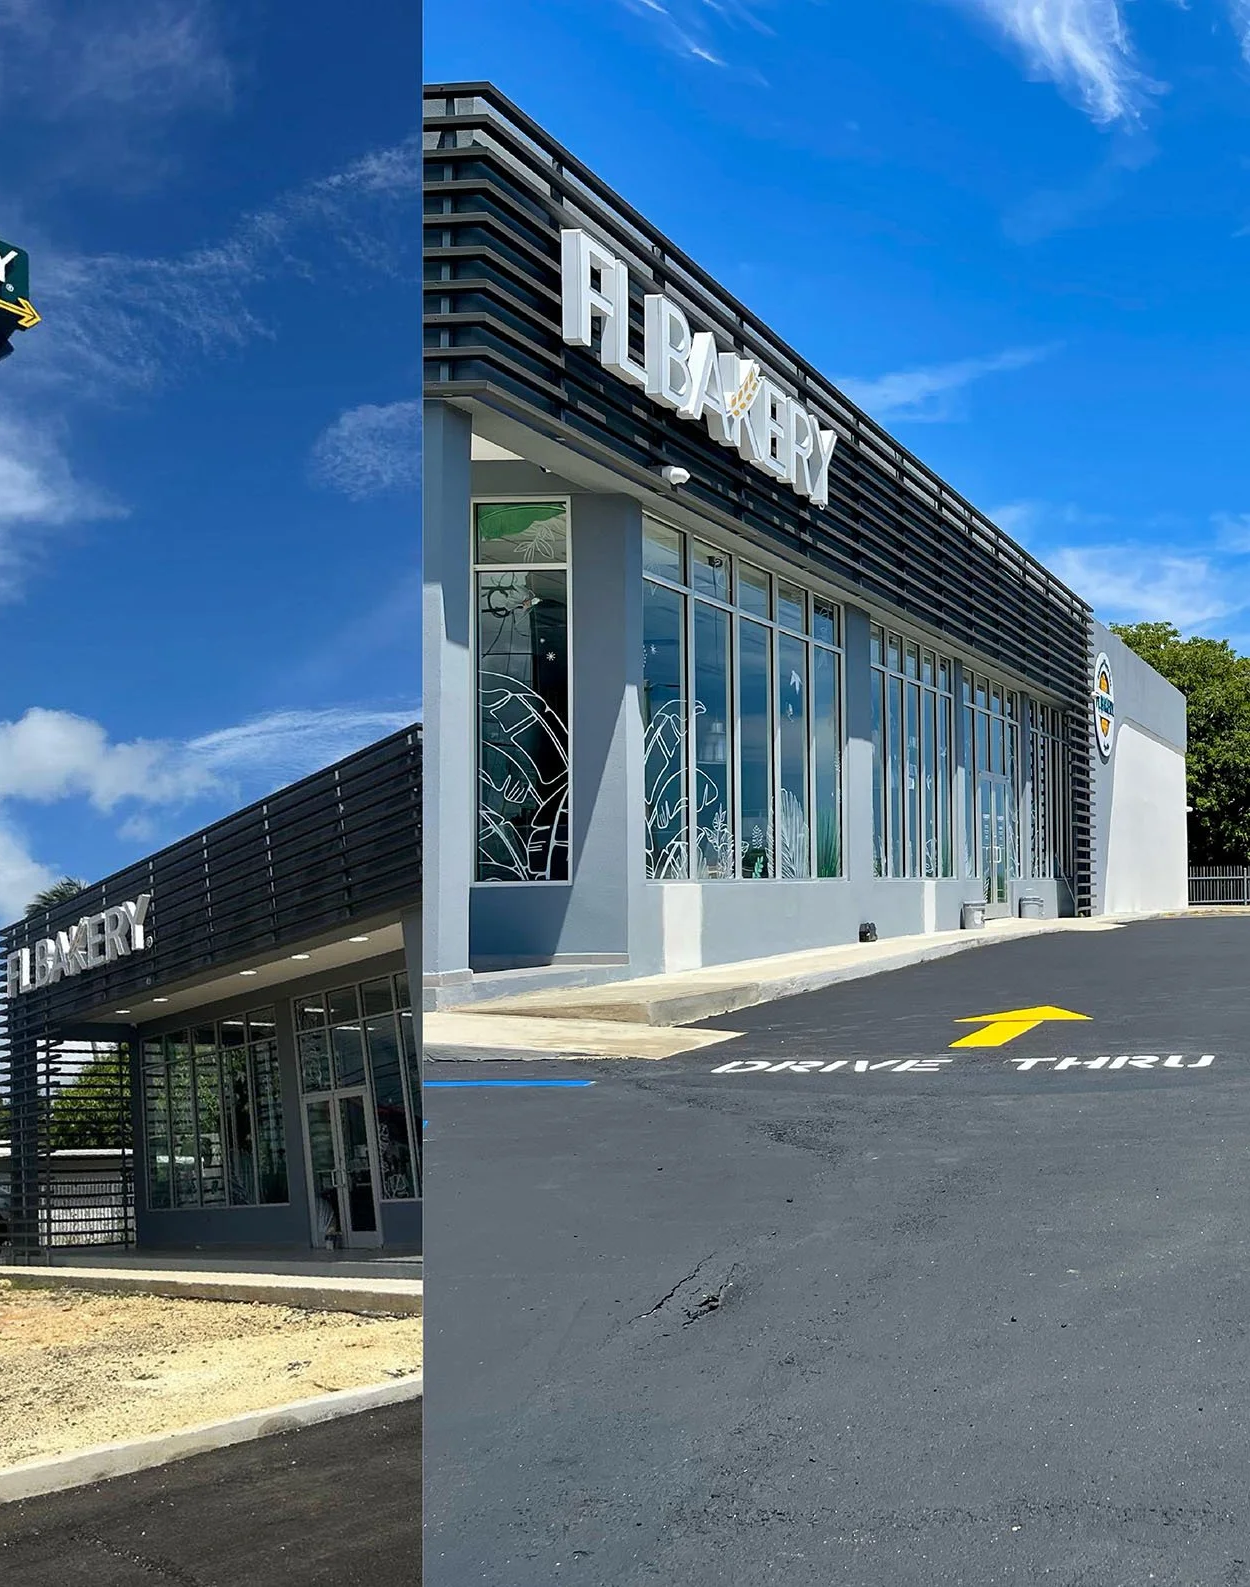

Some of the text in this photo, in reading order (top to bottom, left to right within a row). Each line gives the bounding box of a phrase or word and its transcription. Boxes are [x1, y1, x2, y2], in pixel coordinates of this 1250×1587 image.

[561, 228, 838, 506] FL BAKERY
[6, 893, 151, 999] FL BAKERY
[710, 1054, 1215, 1074] DRIVE THRU
